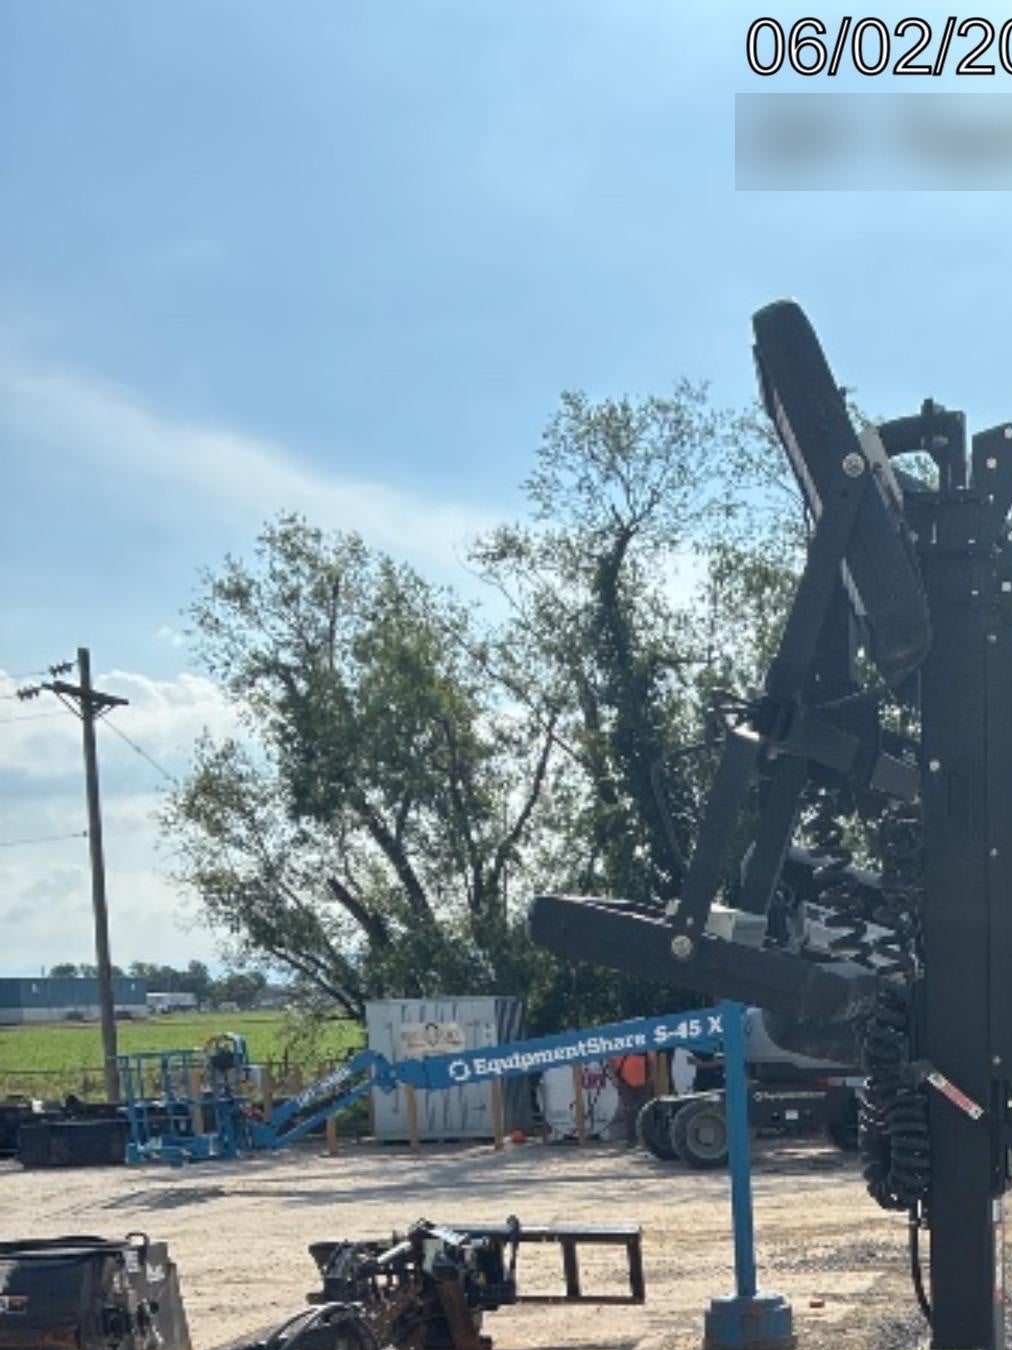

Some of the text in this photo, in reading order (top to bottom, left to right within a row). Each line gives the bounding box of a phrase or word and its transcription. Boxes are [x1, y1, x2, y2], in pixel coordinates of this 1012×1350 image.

[473, 1034, 646, 1075] EquipmentShare
[653, 1019, 702, 1044] S-45
[707, 1015, 723, 1035] X
